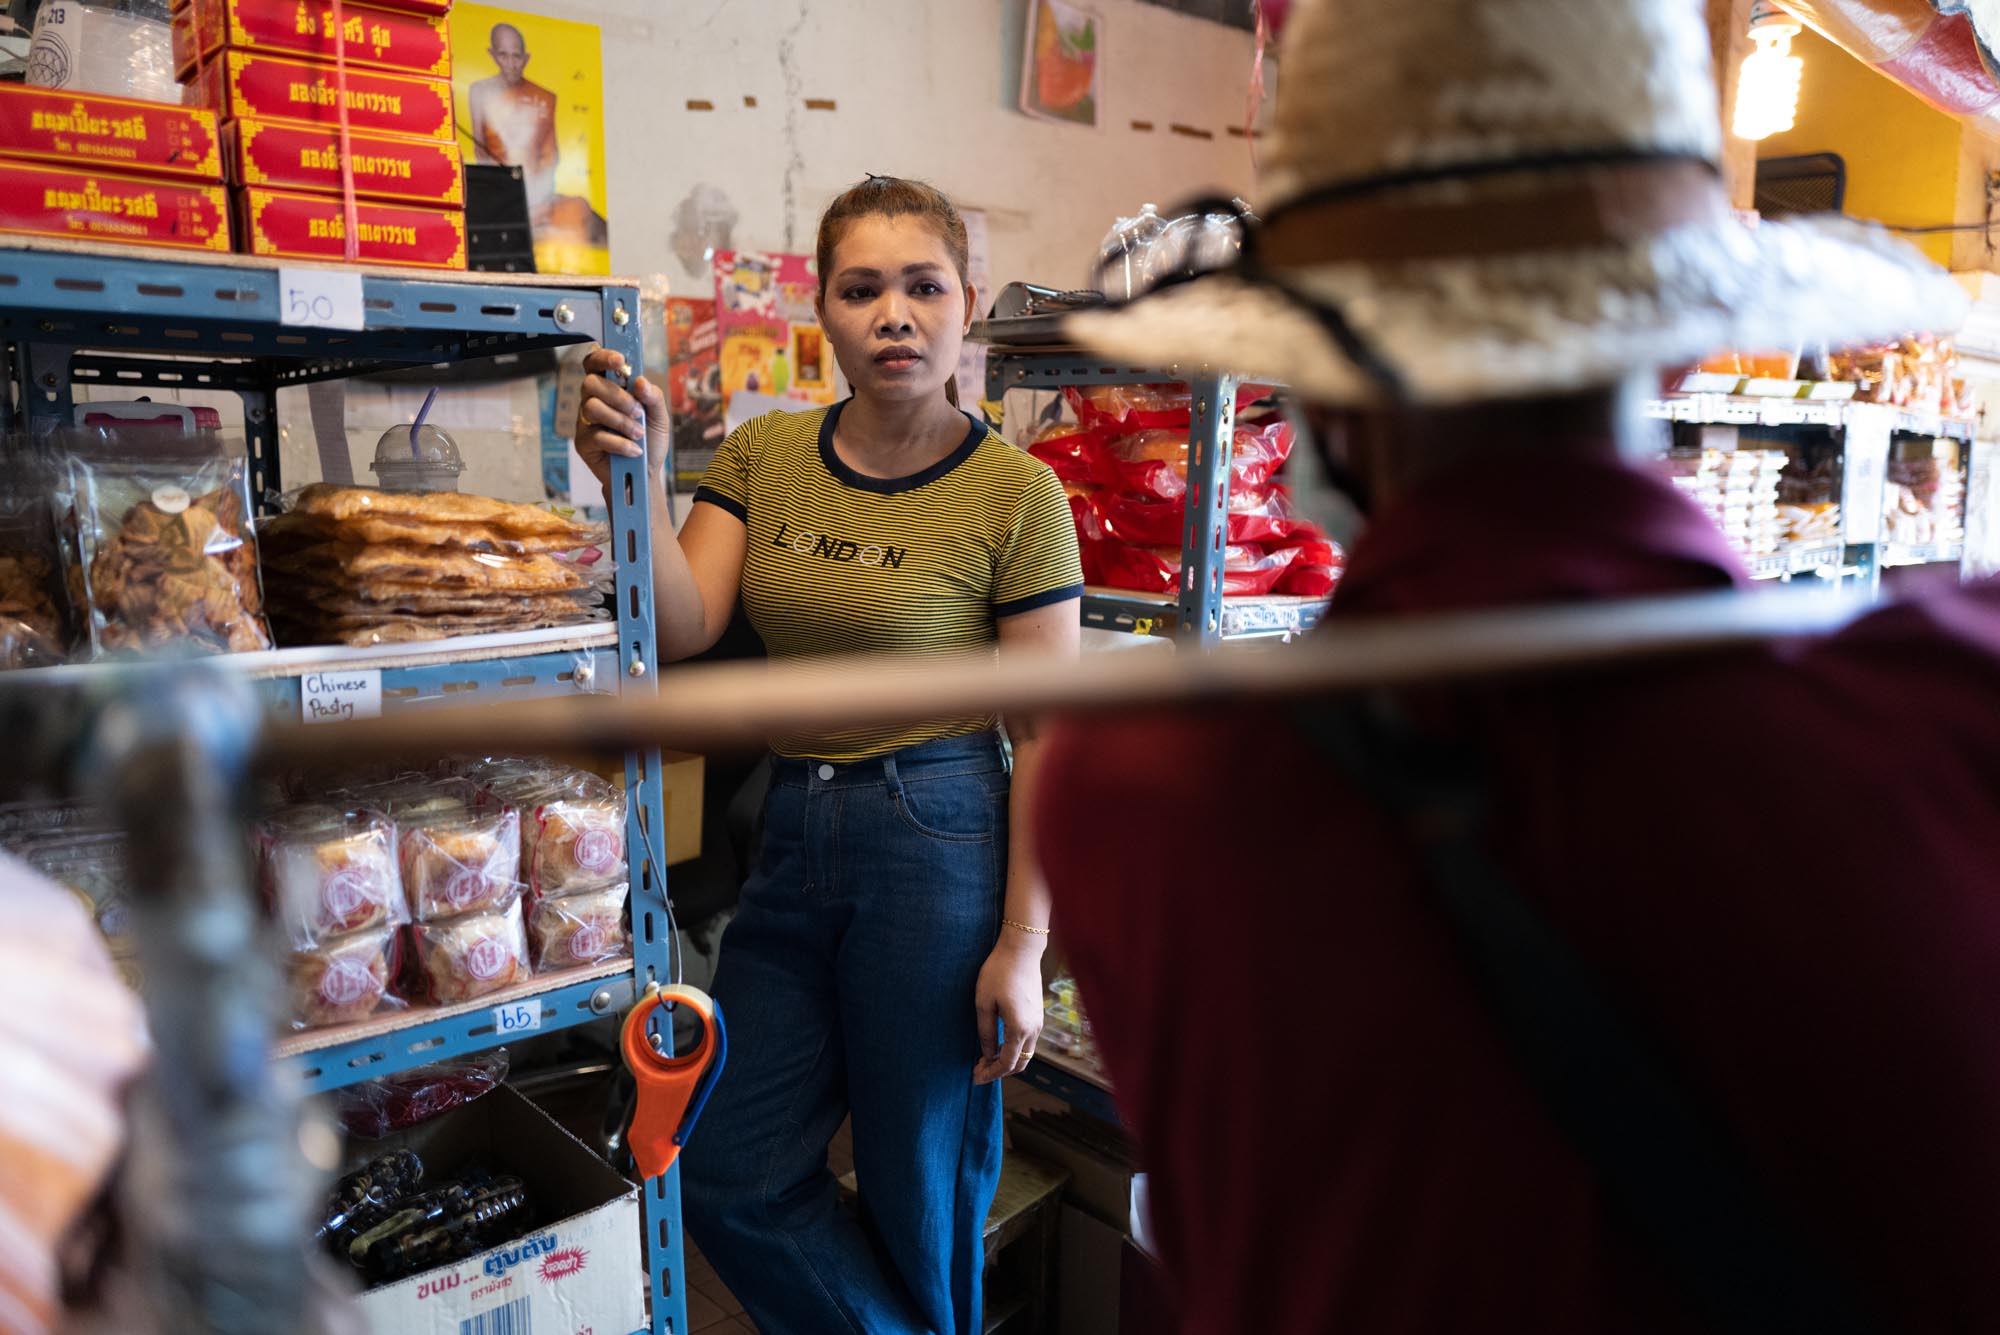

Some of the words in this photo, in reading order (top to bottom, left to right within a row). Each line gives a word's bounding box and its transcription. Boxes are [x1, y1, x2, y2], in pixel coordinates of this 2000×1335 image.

[47, 7, 65, 24] 213
[289, 288, 333, 323] 50
[772, 522, 907, 569] LONDON
[306, 672, 368, 694] Chinese
[309, 697, 354, 721] Pastry
